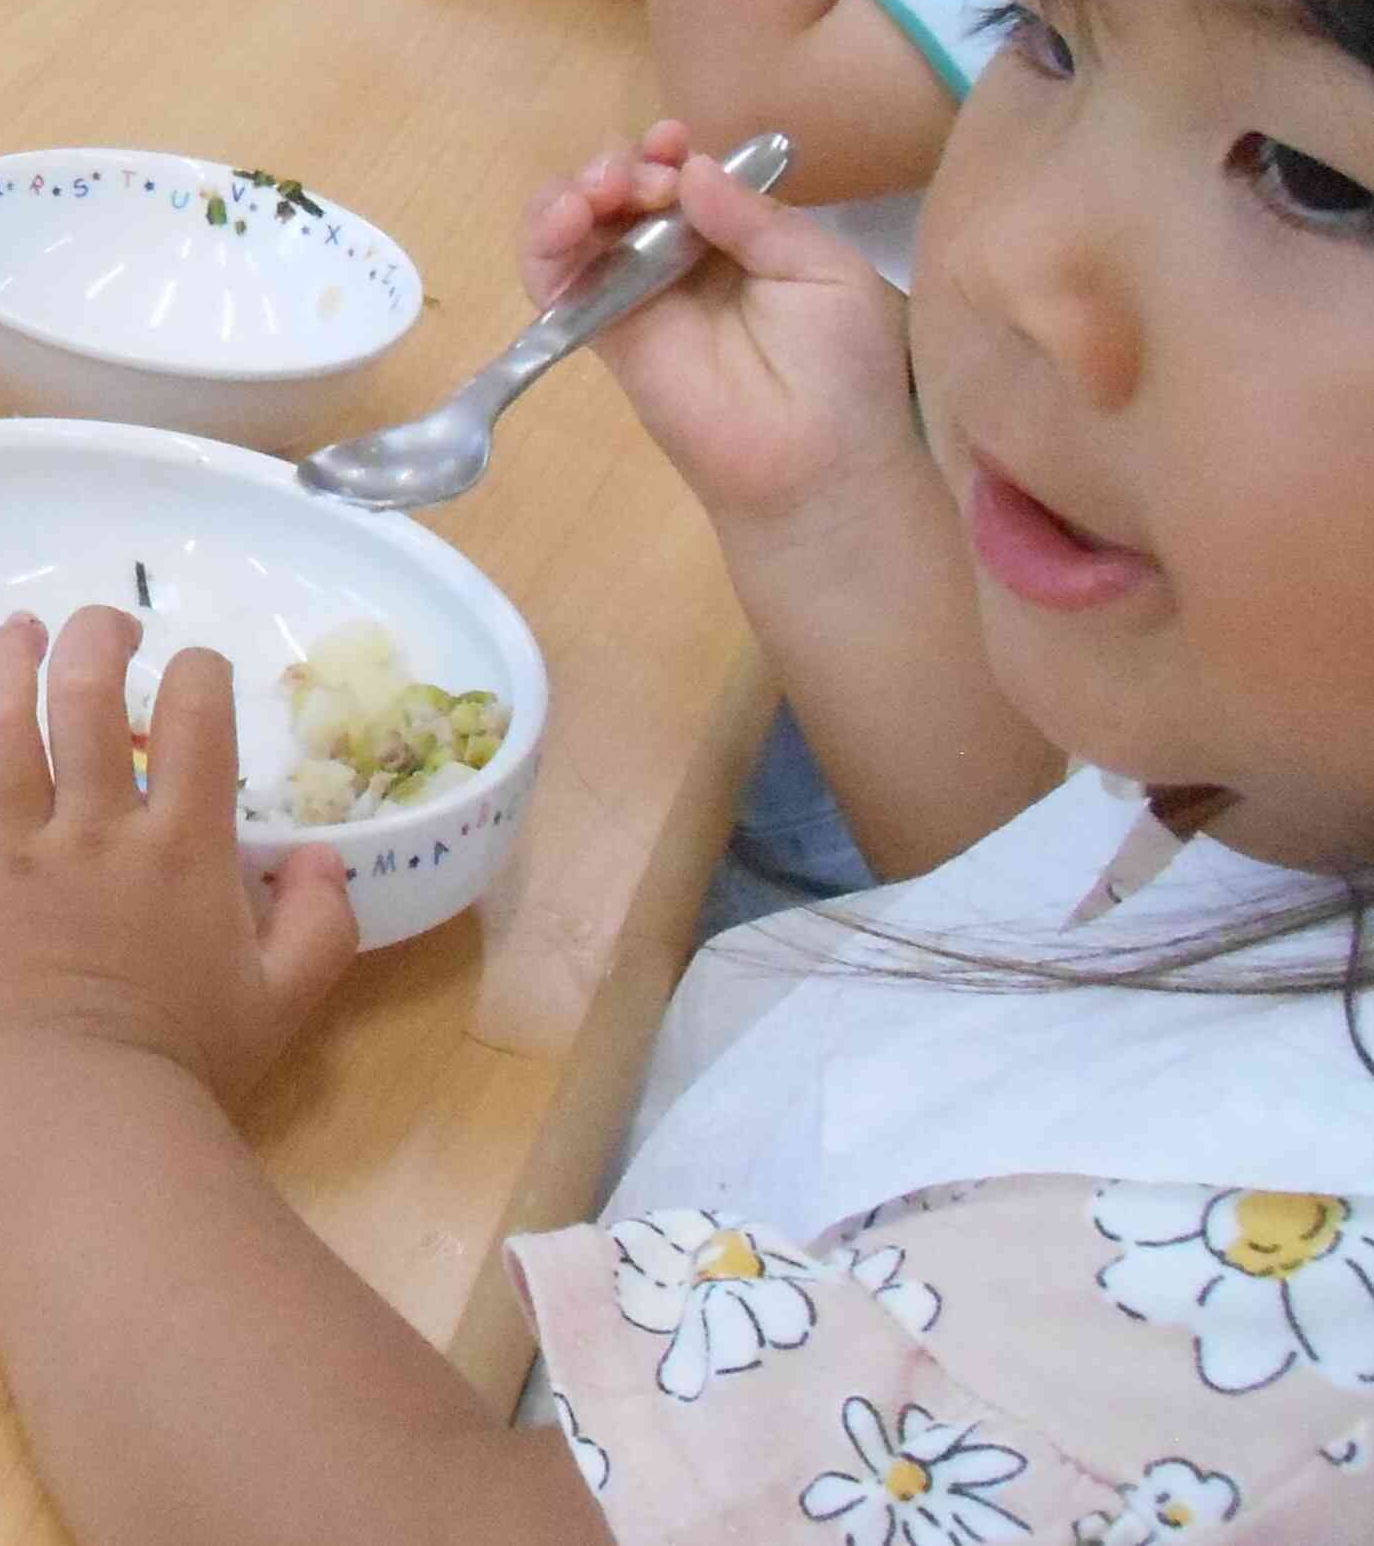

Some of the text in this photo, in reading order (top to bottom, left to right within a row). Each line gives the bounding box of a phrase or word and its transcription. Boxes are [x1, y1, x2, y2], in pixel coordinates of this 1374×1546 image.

[29, 174, 44, 195] R
[73, 178, 89, 198] S
[121, 169, 137, 188] T
[170, 190, 190, 210] U
[232, 183, 245, 203] V
[325, 225, 341, 245] X
[373, 850, 396, 876] M
